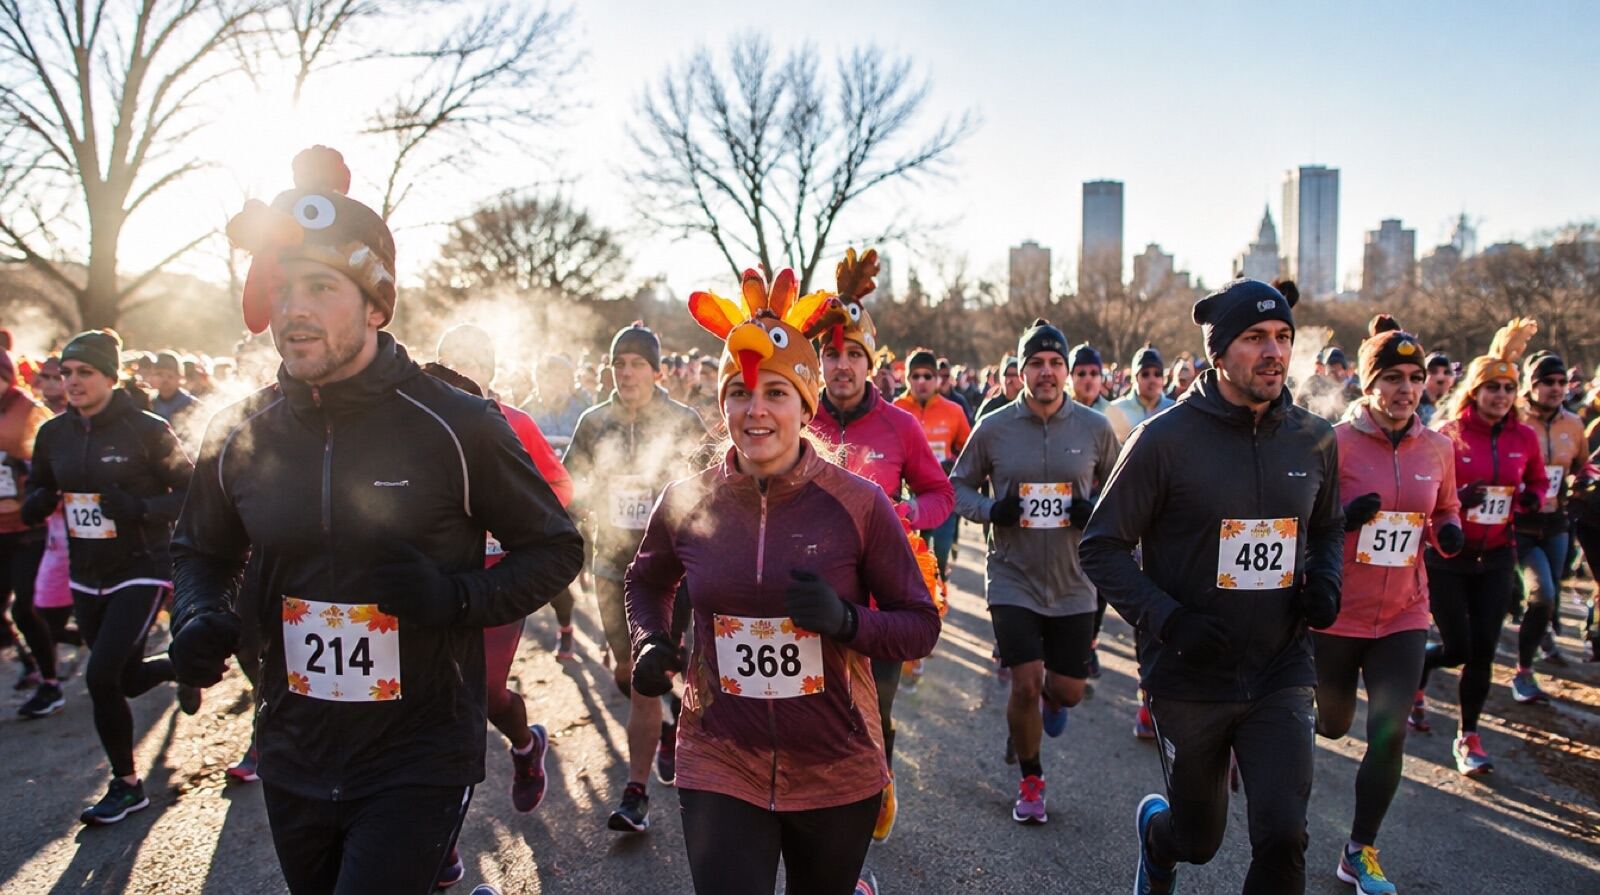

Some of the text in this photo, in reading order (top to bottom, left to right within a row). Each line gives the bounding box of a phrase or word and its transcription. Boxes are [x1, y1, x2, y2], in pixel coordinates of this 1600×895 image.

[73, 508, 102, 526] 126
[1030, 498, 1062, 517] 293
[1372, 529, 1412, 553] 517
[1235, 543, 1283, 571] 482
[305, 633, 374, 676] 214
[736, 643, 801, 677] 368
